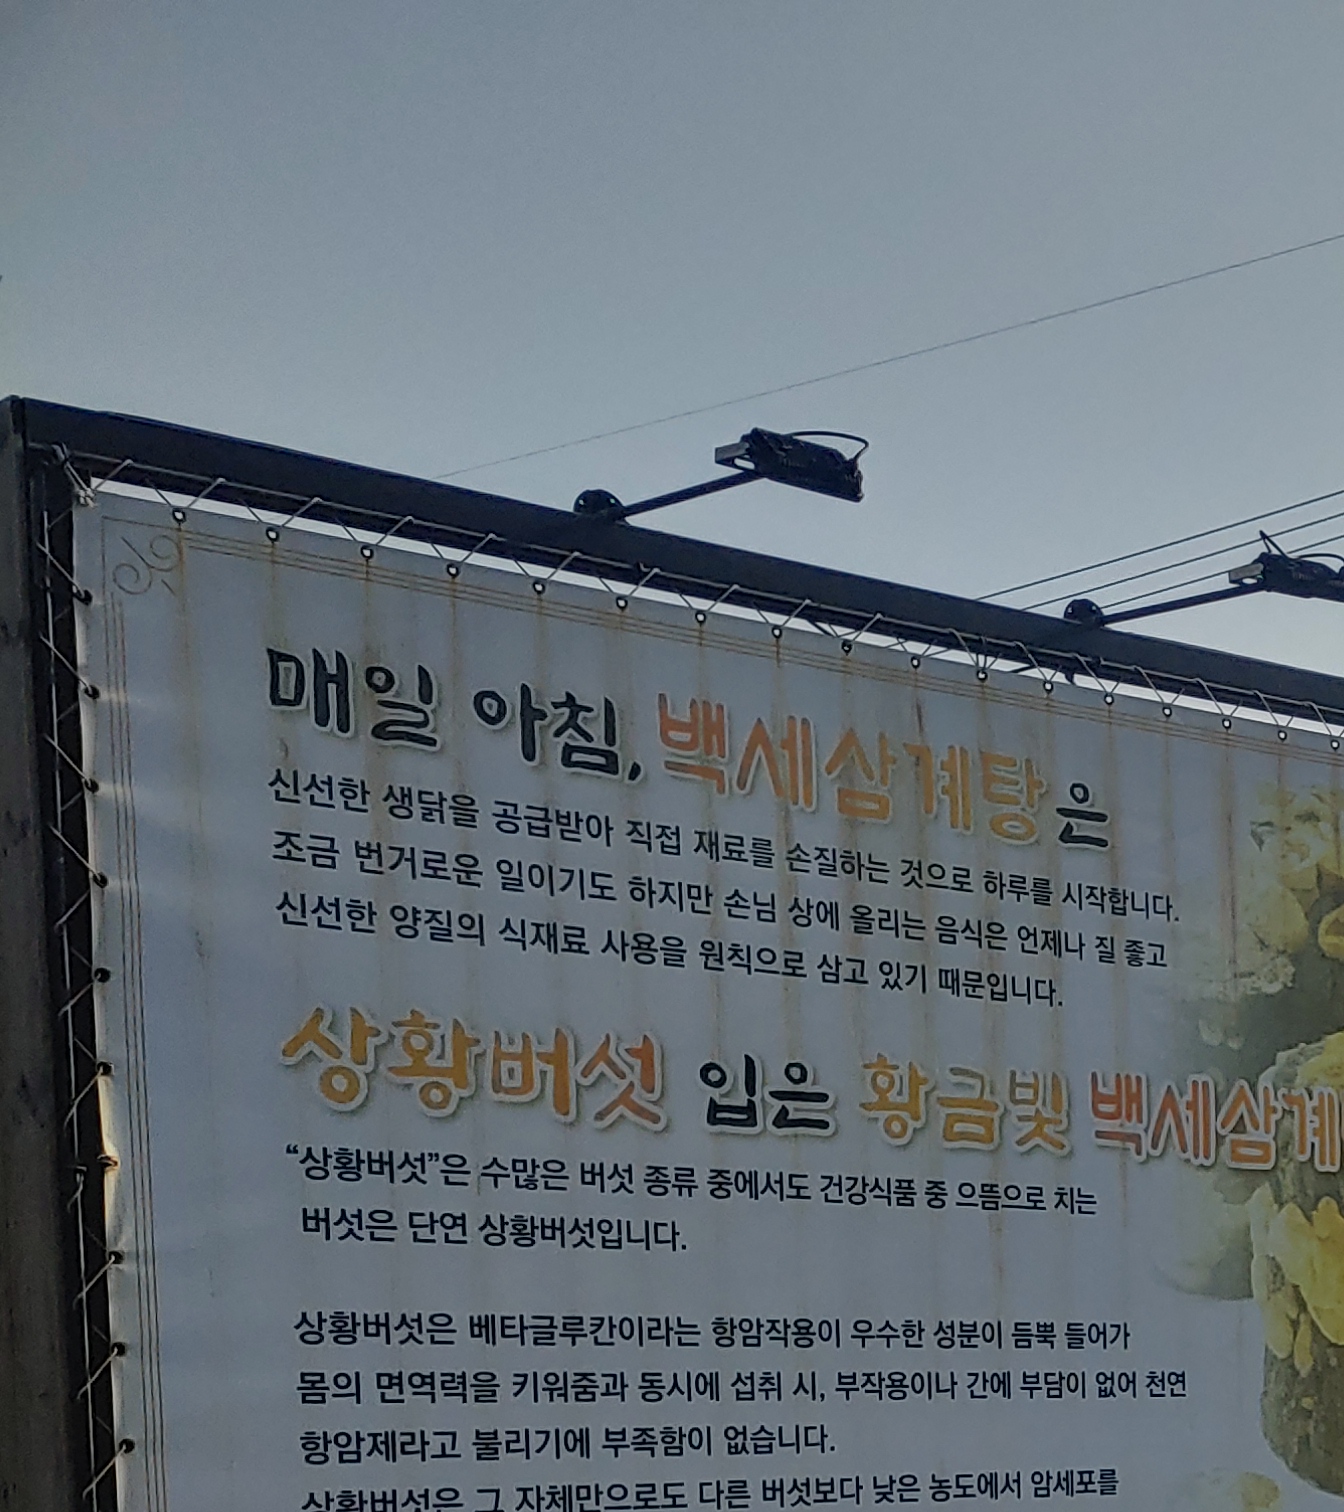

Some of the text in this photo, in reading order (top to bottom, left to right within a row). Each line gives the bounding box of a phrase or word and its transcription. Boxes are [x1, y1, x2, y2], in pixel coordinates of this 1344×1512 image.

[266, 647, 437, 747] 매일
[473, 682, 642, 781] 아침,
[267, 767, 1180, 923] 신선한 생닭을 공급받아 직접 재료를 손질하는 것으로 하루를 시작합니다.
[271, 830, 1168, 968] 조금 번거로운 일이기도 하지만 손님 상에 올리는 음식은 언제나 질 좋고
[275, 891, 1063, 1008] 신선한 양질의 식재료 사용을 원칙으로 삼고 있기 때문입니다.
[281, 1007, 662, 1127] 상황버섯
[700, 1053, 830, 1130] 입은
[860, 1052, 1068, 1153] 황금빛
[477, 1156, 570, 1195] 수많은
[580, 1161, 635, 1195] 버섯
[643, 1165, 699, 1198] 종류
[706, 1168, 812, 1202] 중에서도
[819, 1174, 918, 1208] 건강식품
[924, 1179, 949, 1210] 중
[955, 1182, 1047, 1212] 으뜸으로
[1053, 1186, 1098, 1216] 치는
[301, 1206, 687, 1253] 버섯은 단연 상황버섯입니다.
[293, 1310, 1131, 1351] 상황버섯은 베타글루칸이라는 항암작용이 우수한 성분이 듬뿍 들어가
[296, 1369, 1187, 1405] 몸의 면역력을 키워줌과 동시에 섭취 시, 부작용이나 간에 부담이 없어 천연
[299, 1423, 836, 1466] 항암제라고 불리기에 부족함이 없습니다.
[698, 1479, 752, 1511] 다른
[761, 1475, 864, 1509] 버섯보다
[872, 1473, 922, 1505] 낮은
[928, 1470, 1022, 1503] 농도에서
[1030, 1468, 1120, 1499] 암세포를
